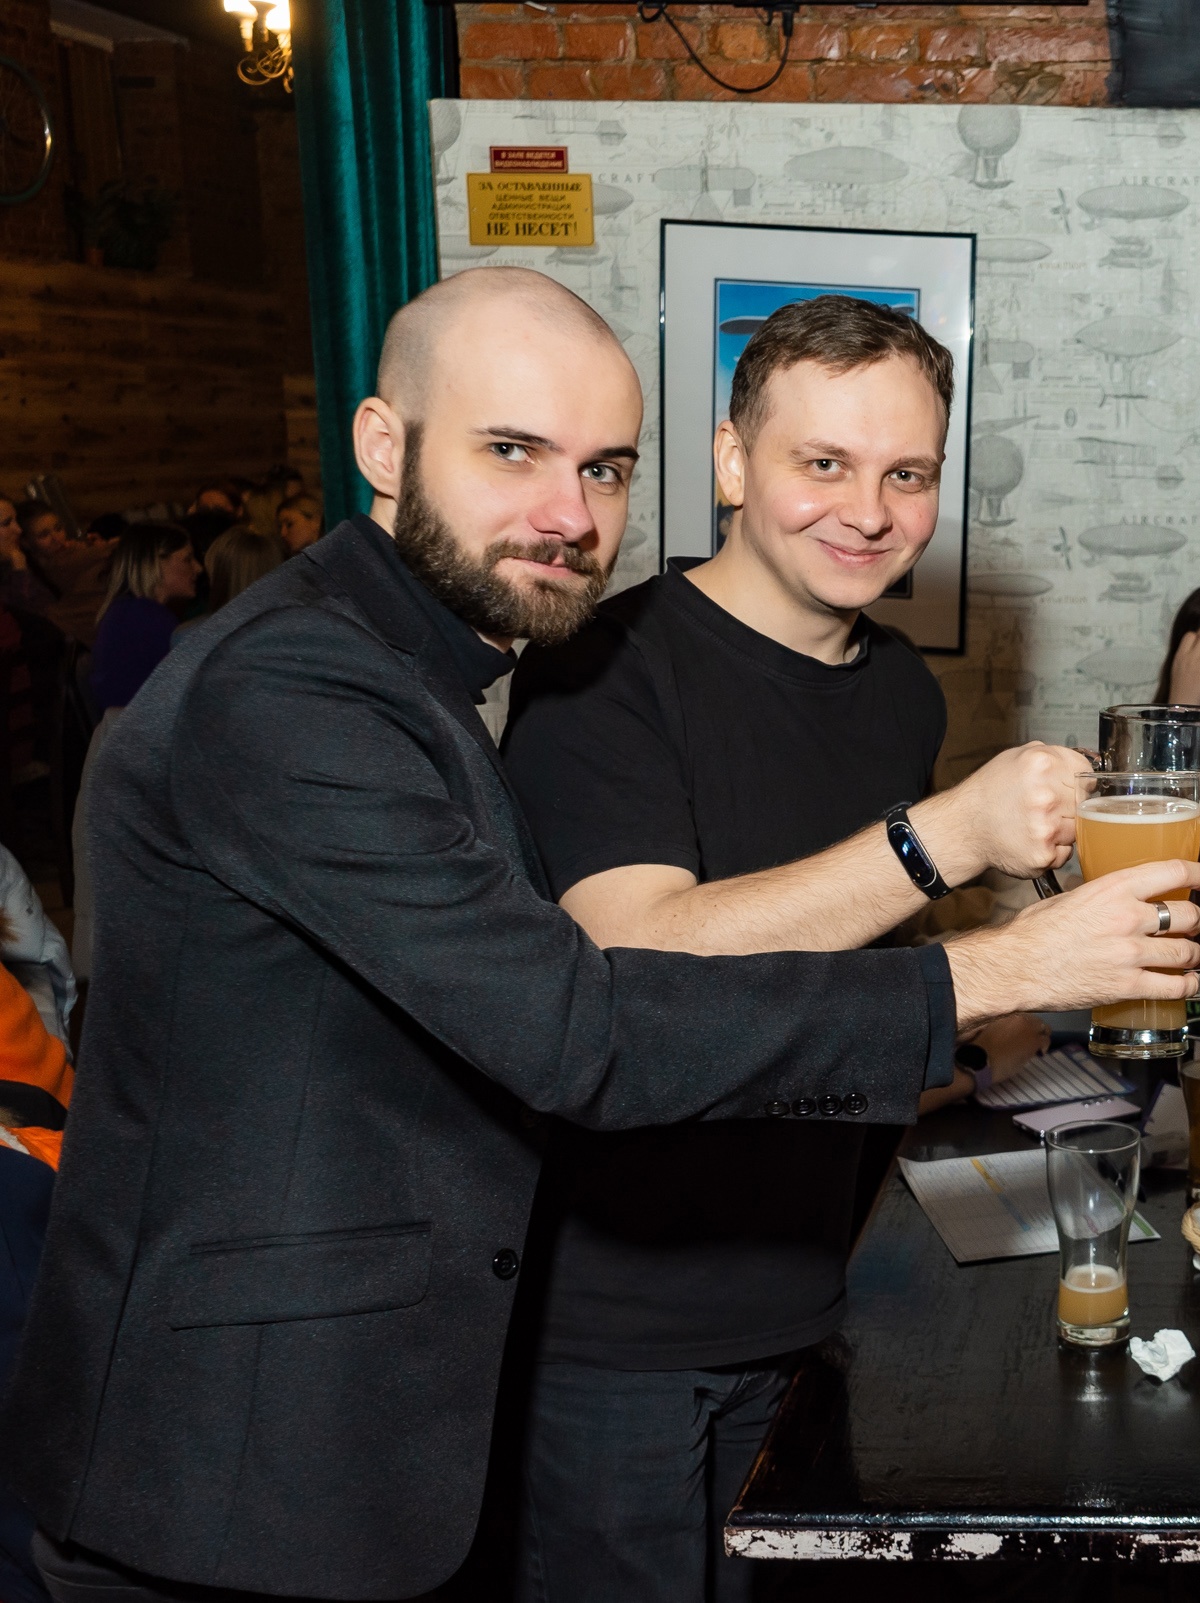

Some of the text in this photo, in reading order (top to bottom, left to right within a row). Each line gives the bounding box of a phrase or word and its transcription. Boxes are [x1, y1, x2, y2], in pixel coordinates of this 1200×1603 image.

[598, 172, 656, 184] CRAFT
[479, 181, 582, 192] ЗА ОСТАВЛЕННЫЕ
[495, 194, 567, 202] ЦЕННЫЕ ВЕЩИ
[491, 203, 572, 211] АДМИНИСТРАЦИЯ
[488, 212, 575, 221] ОТВЕТСТВЕННОСТИ
[486, 221, 578, 236] НЕ НЕСЕТ!
